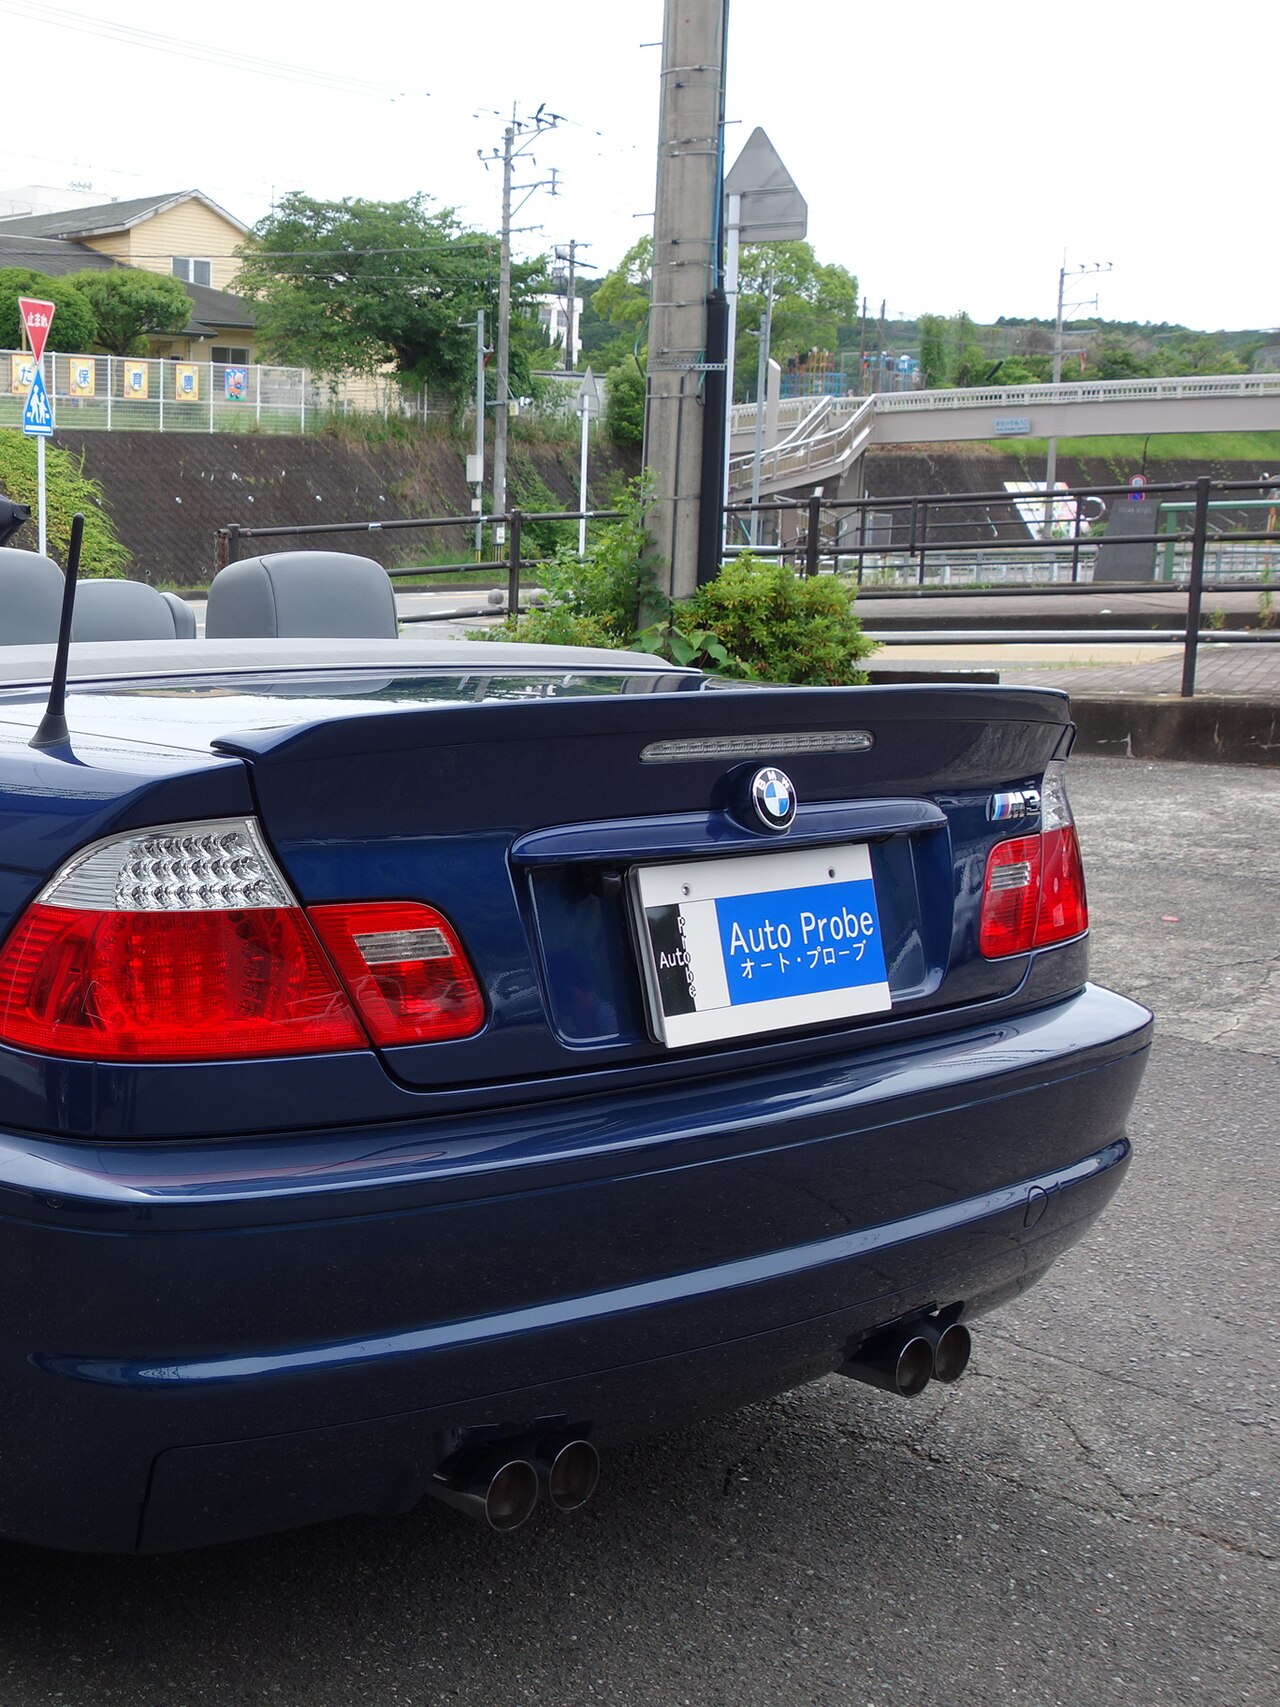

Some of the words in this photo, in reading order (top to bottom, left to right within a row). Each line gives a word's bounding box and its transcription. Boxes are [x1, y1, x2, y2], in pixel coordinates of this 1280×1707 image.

[27, 311, 48, 328] 止まれ
[756, 770, 790, 791] BMW
[1005, 790, 1041, 818] M3
[730, 919, 792, 956] Auto
[800, 906, 874, 945] Probe
[659, 947, 692, 970] Auto
[677, 916, 698, 999] Probe
